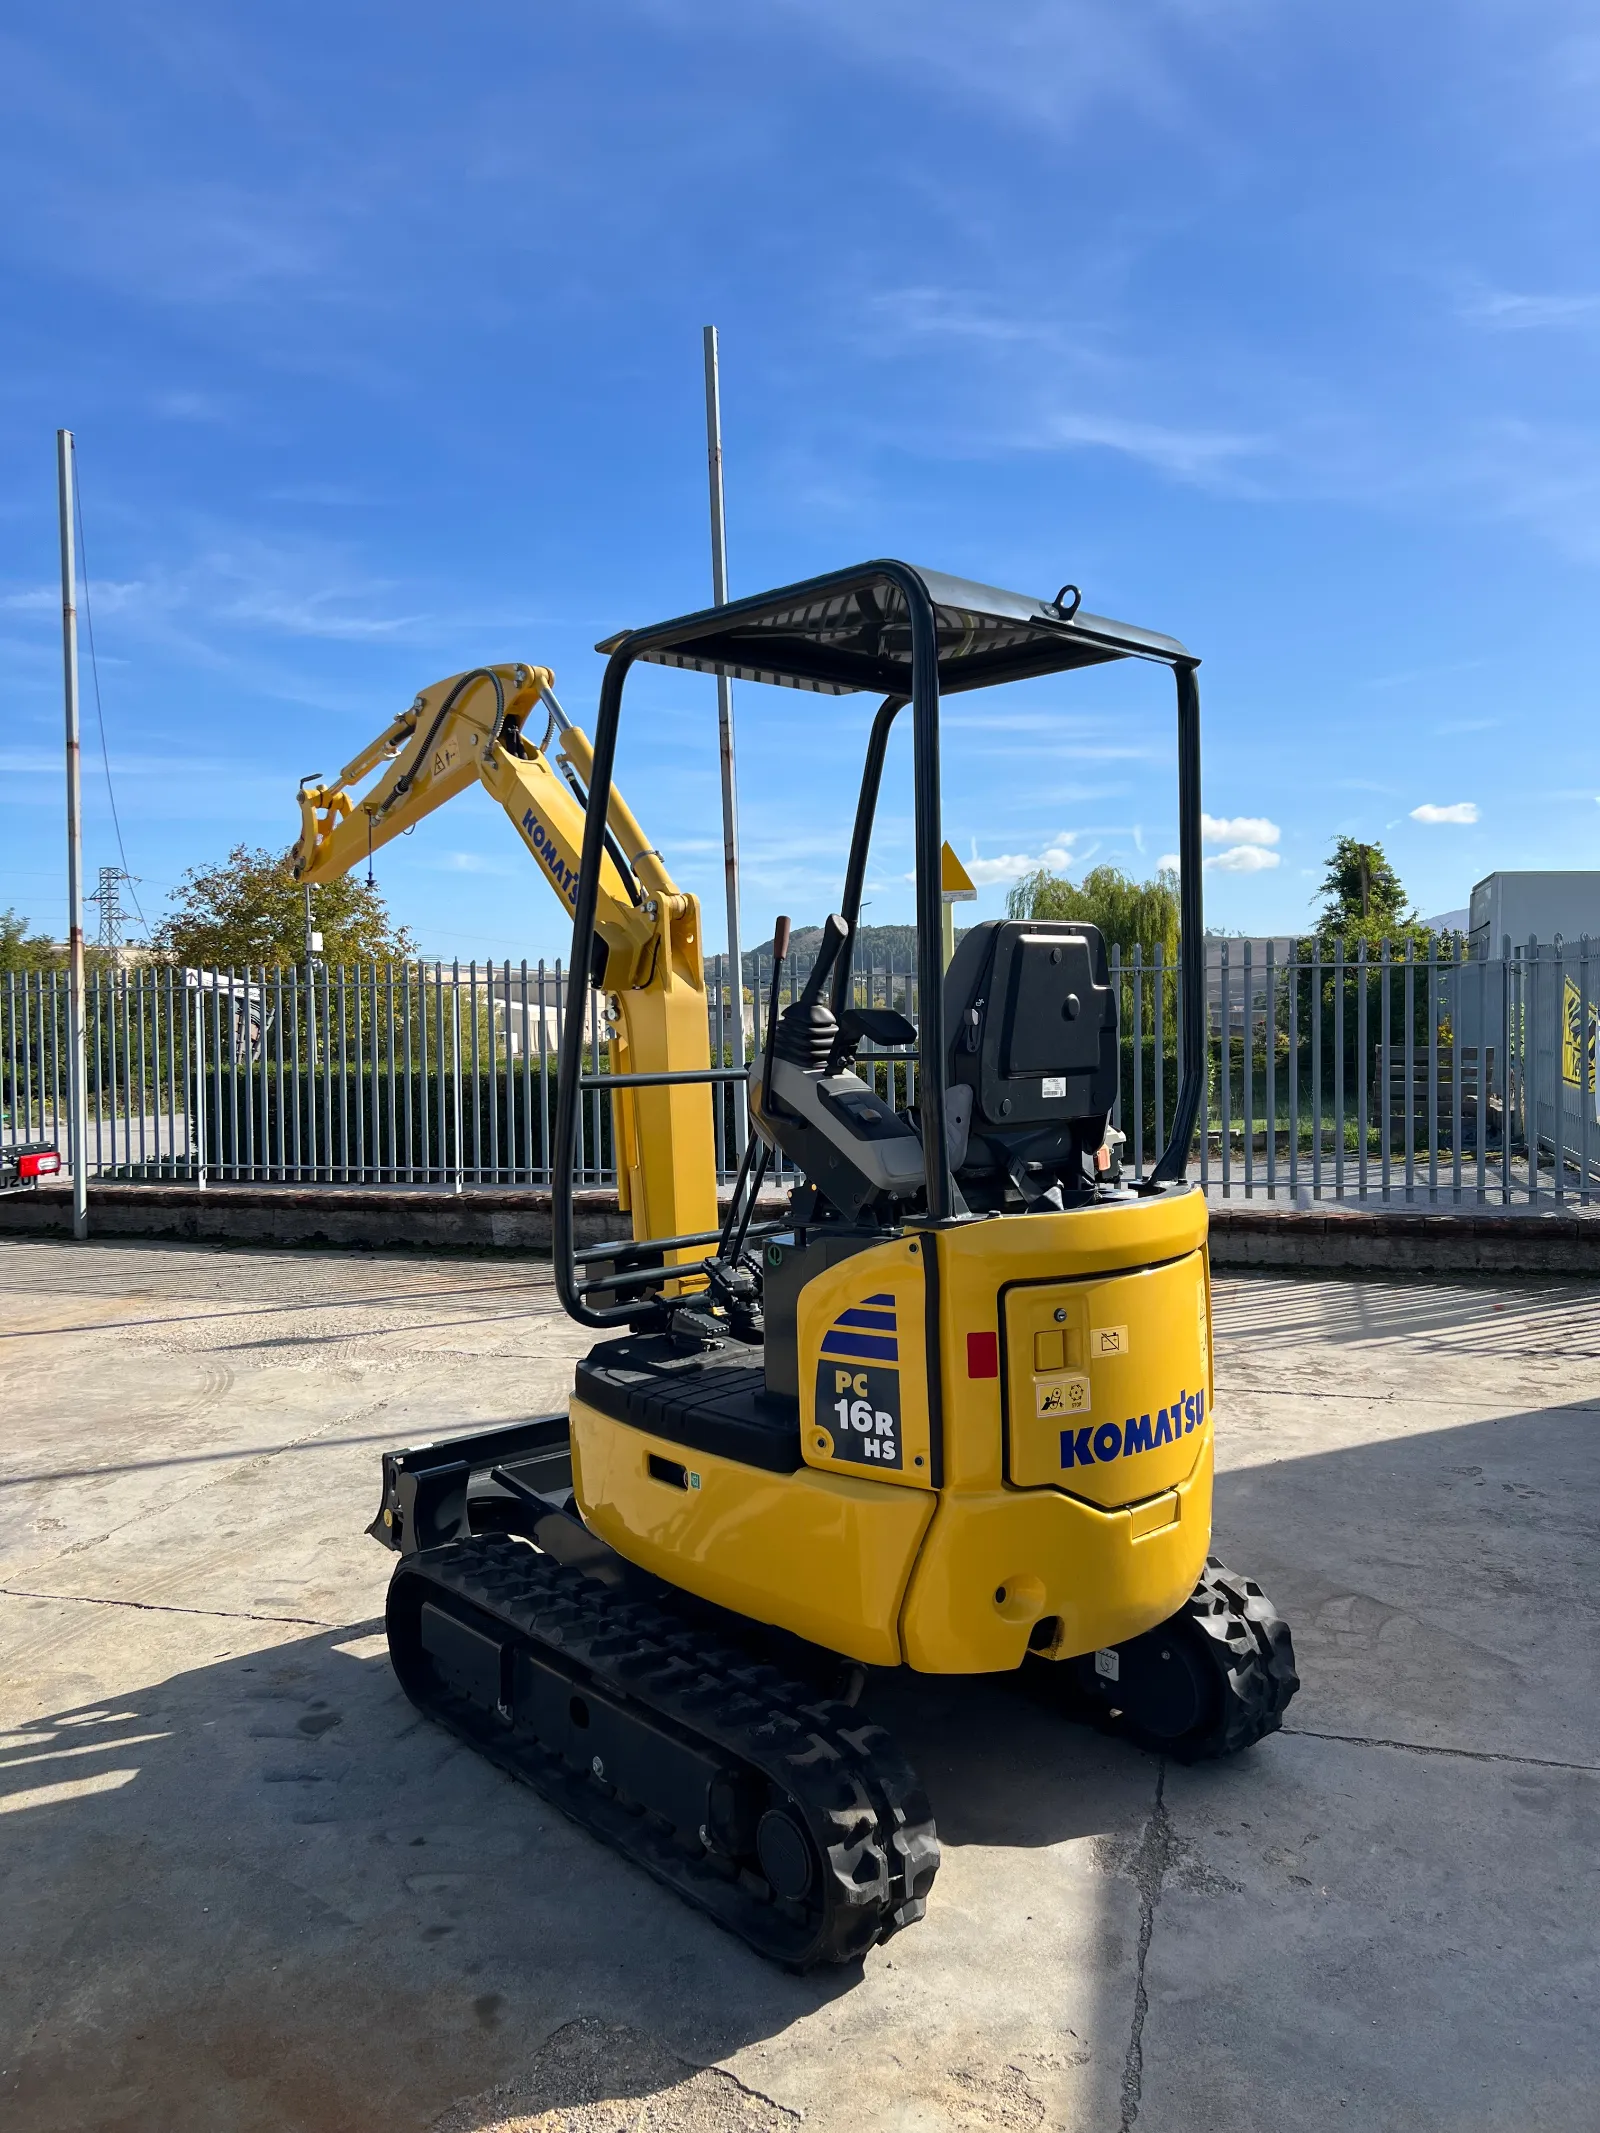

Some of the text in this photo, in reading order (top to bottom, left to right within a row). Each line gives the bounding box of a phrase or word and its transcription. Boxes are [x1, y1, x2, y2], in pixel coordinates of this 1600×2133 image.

[522, 807, 580, 906] KOMATS
[835, 1369, 868, 1398] PC
[834, 1398, 895, 1437] 16R
[1060, 1388, 1205, 1470] KOMATSU
[864, 1437, 896, 1461] HS
